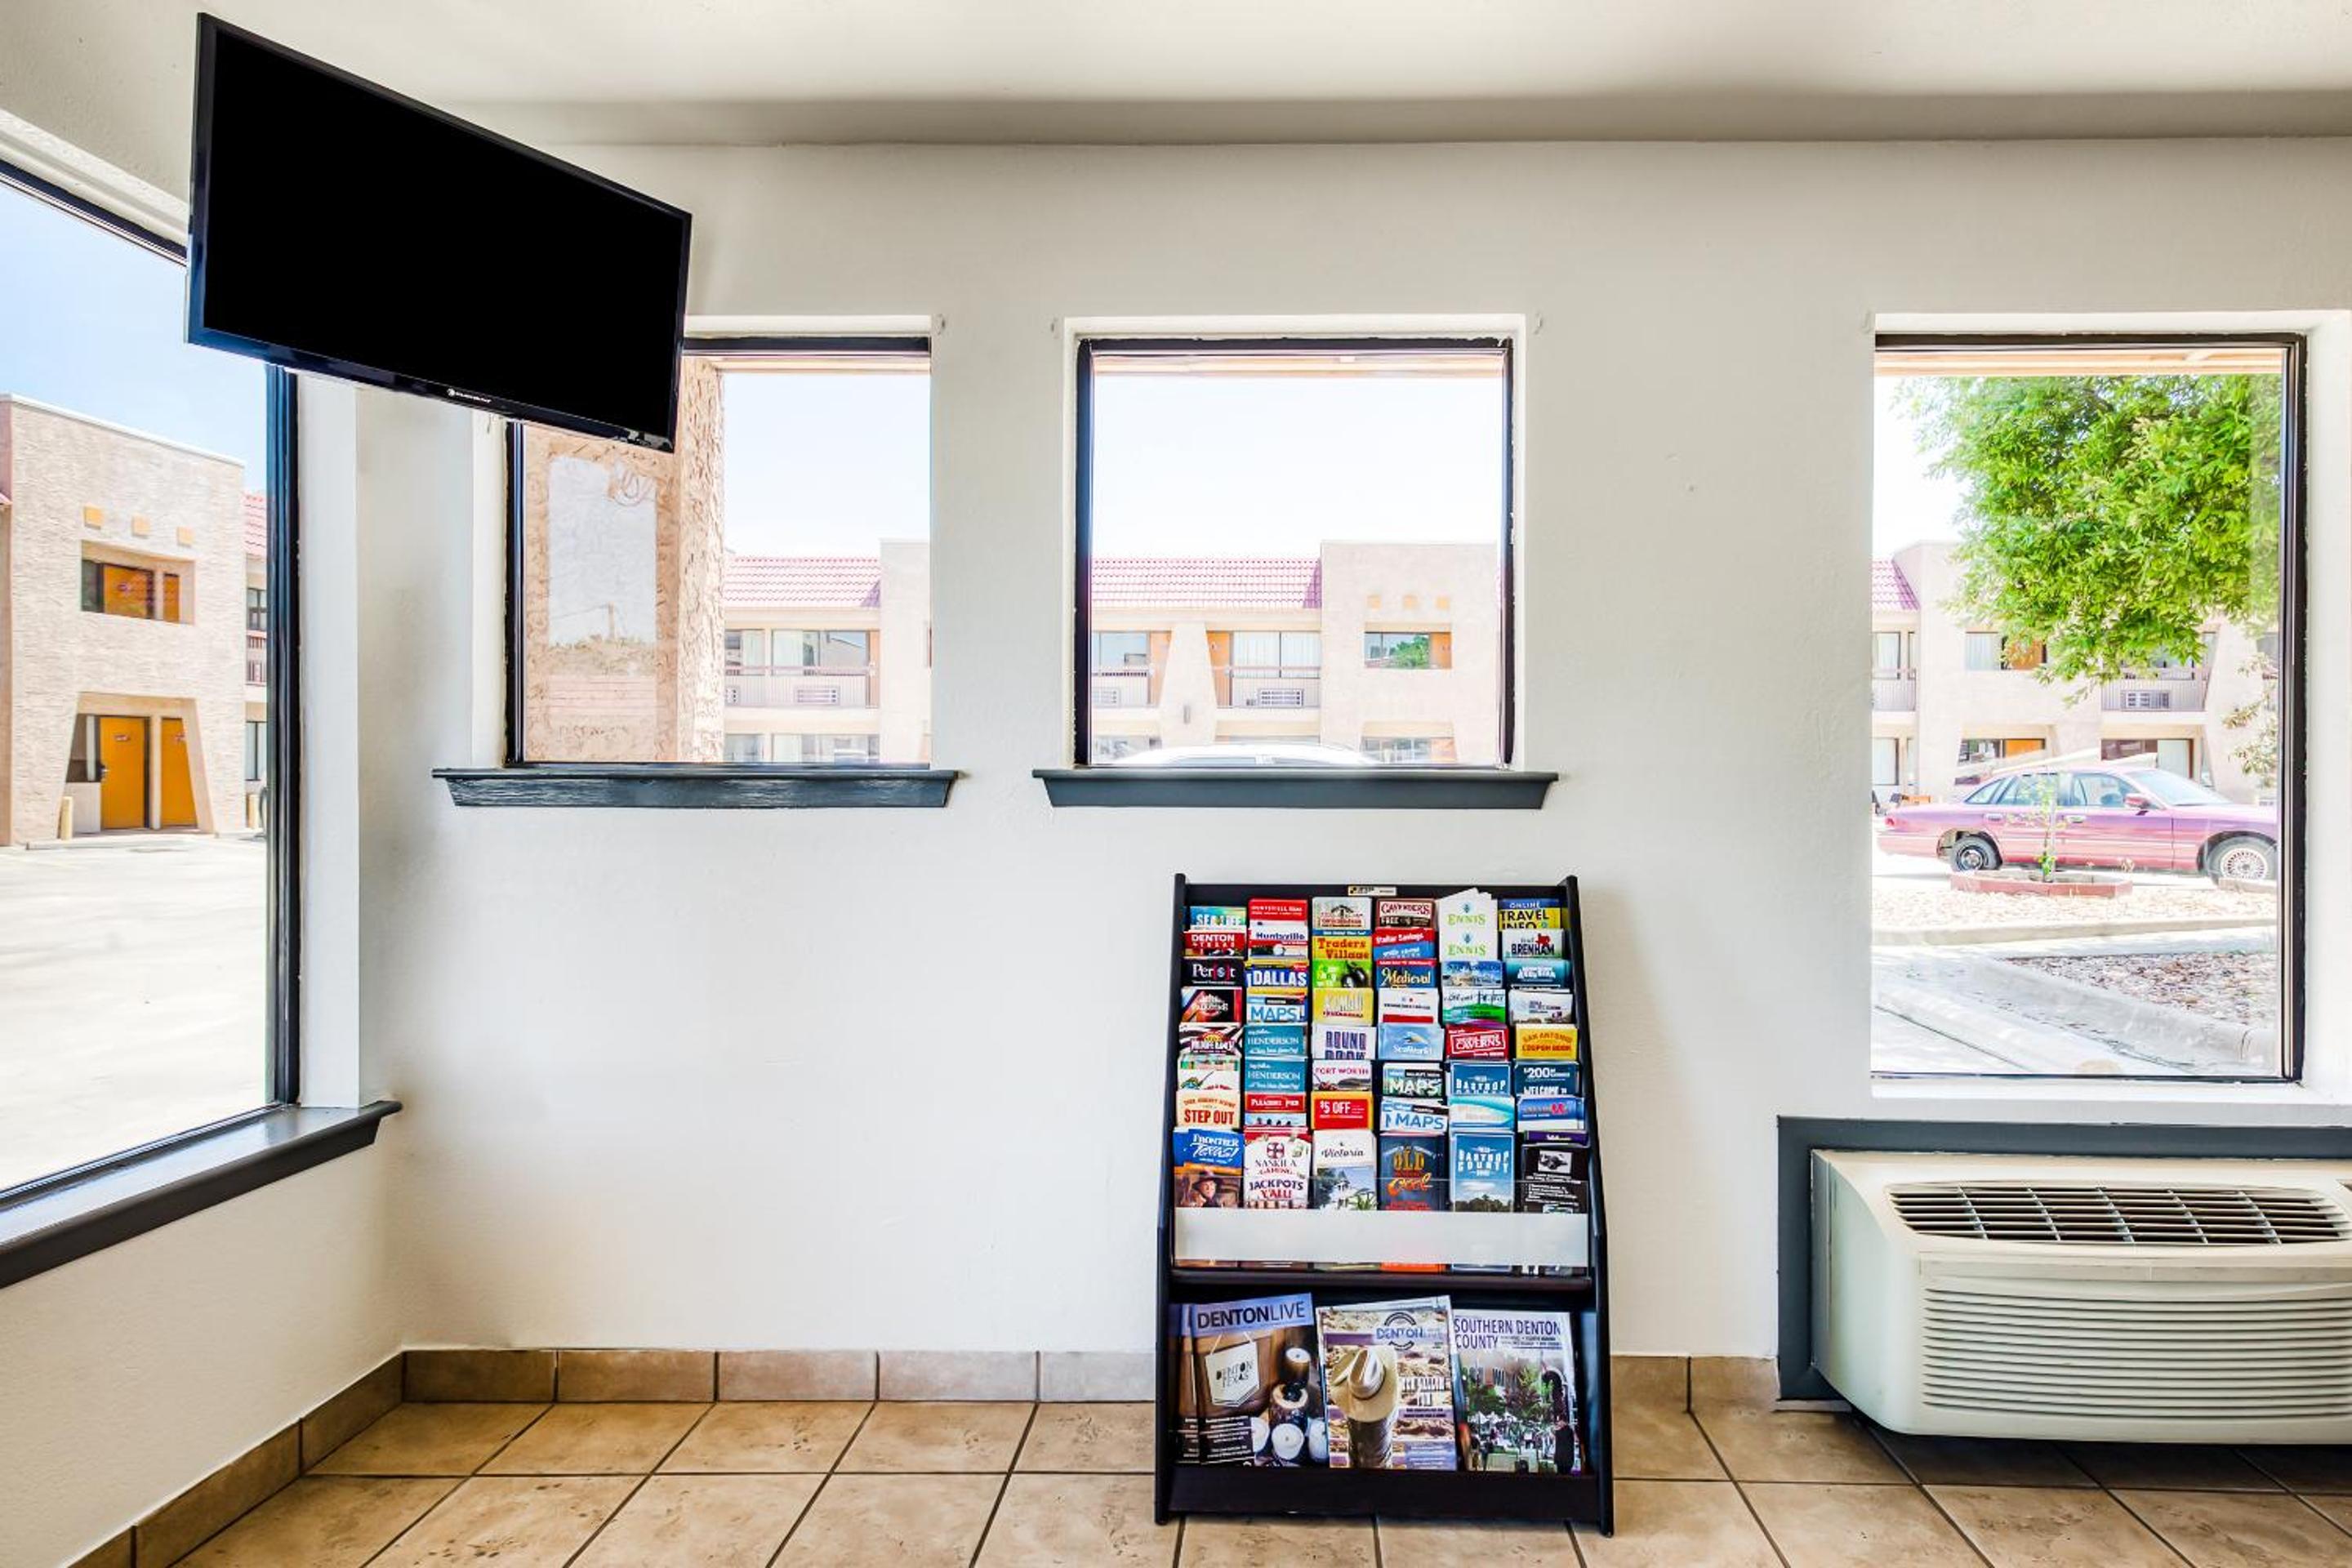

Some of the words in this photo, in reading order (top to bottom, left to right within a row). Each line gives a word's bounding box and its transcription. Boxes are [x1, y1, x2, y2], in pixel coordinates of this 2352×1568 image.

[1446, 914, 1486, 925] ENNIS
[1500, 911, 1549, 920] TRAVEL
[1192, 933, 1235, 942] DENTON
[1256, 932, 1305, 940] Huntsville
[1317, 938, 1366, 948] Traders
[1446, 942, 1486, 956] ENNIS
[1512, 944, 1554, 956] BRENHAM
[1253, 970, 1307, 987] DALLAS
[1381, 967, 1431, 986] Medieval
[1250, 1006, 1297, 1021] MAPS
[1456, 1037, 1501, 1049] CAVERNS
[1248, 1071, 1300, 1080] HENDERSON
[1524, 1067, 1550, 1078] $200
[1390, 1079, 1437, 1095] MAPS
[1320, 1101, 1330, 1114] $5
[1333, 1102, 1351, 1114] OFF
[1184, 1110, 1210, 1124] STEP
[1214, 1110, 1234, 1124] OUT
[1396, 1113, 1443, 1129] MAPS
[1321, 1148, 1364, 1158] Victoria
[1250, 1179, 1303, 1191] JACKPOTS
[1197, 1301, 1305, 1329] DENTONLIVE
[1454, 1318, 1512, 1334] SOUTHERN
[1516, 1320, 1561, 1334] DENTON
[1455, 1334, 1499, 1349] COUNTY
